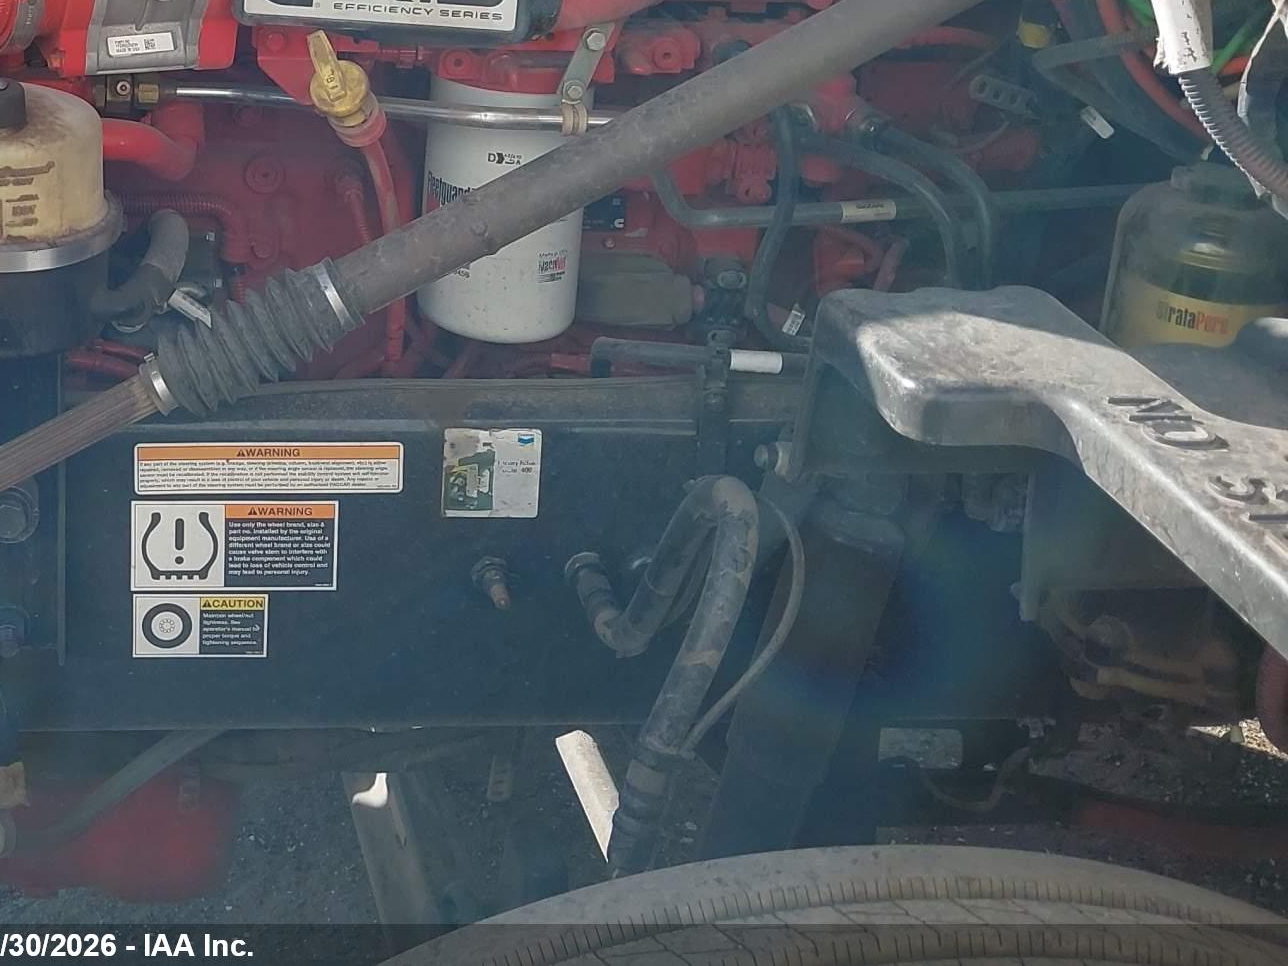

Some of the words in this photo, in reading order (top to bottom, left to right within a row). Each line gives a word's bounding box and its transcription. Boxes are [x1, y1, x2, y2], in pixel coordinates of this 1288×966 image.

[333, 2, 434, 16] EFFICIENCY
[439, 9, 503, 21] SERIES
[245, 448, 301, 458] WARNING
[257, 507, 313, 516] WARNING
[212, 599, 264, 608] CAUTION
